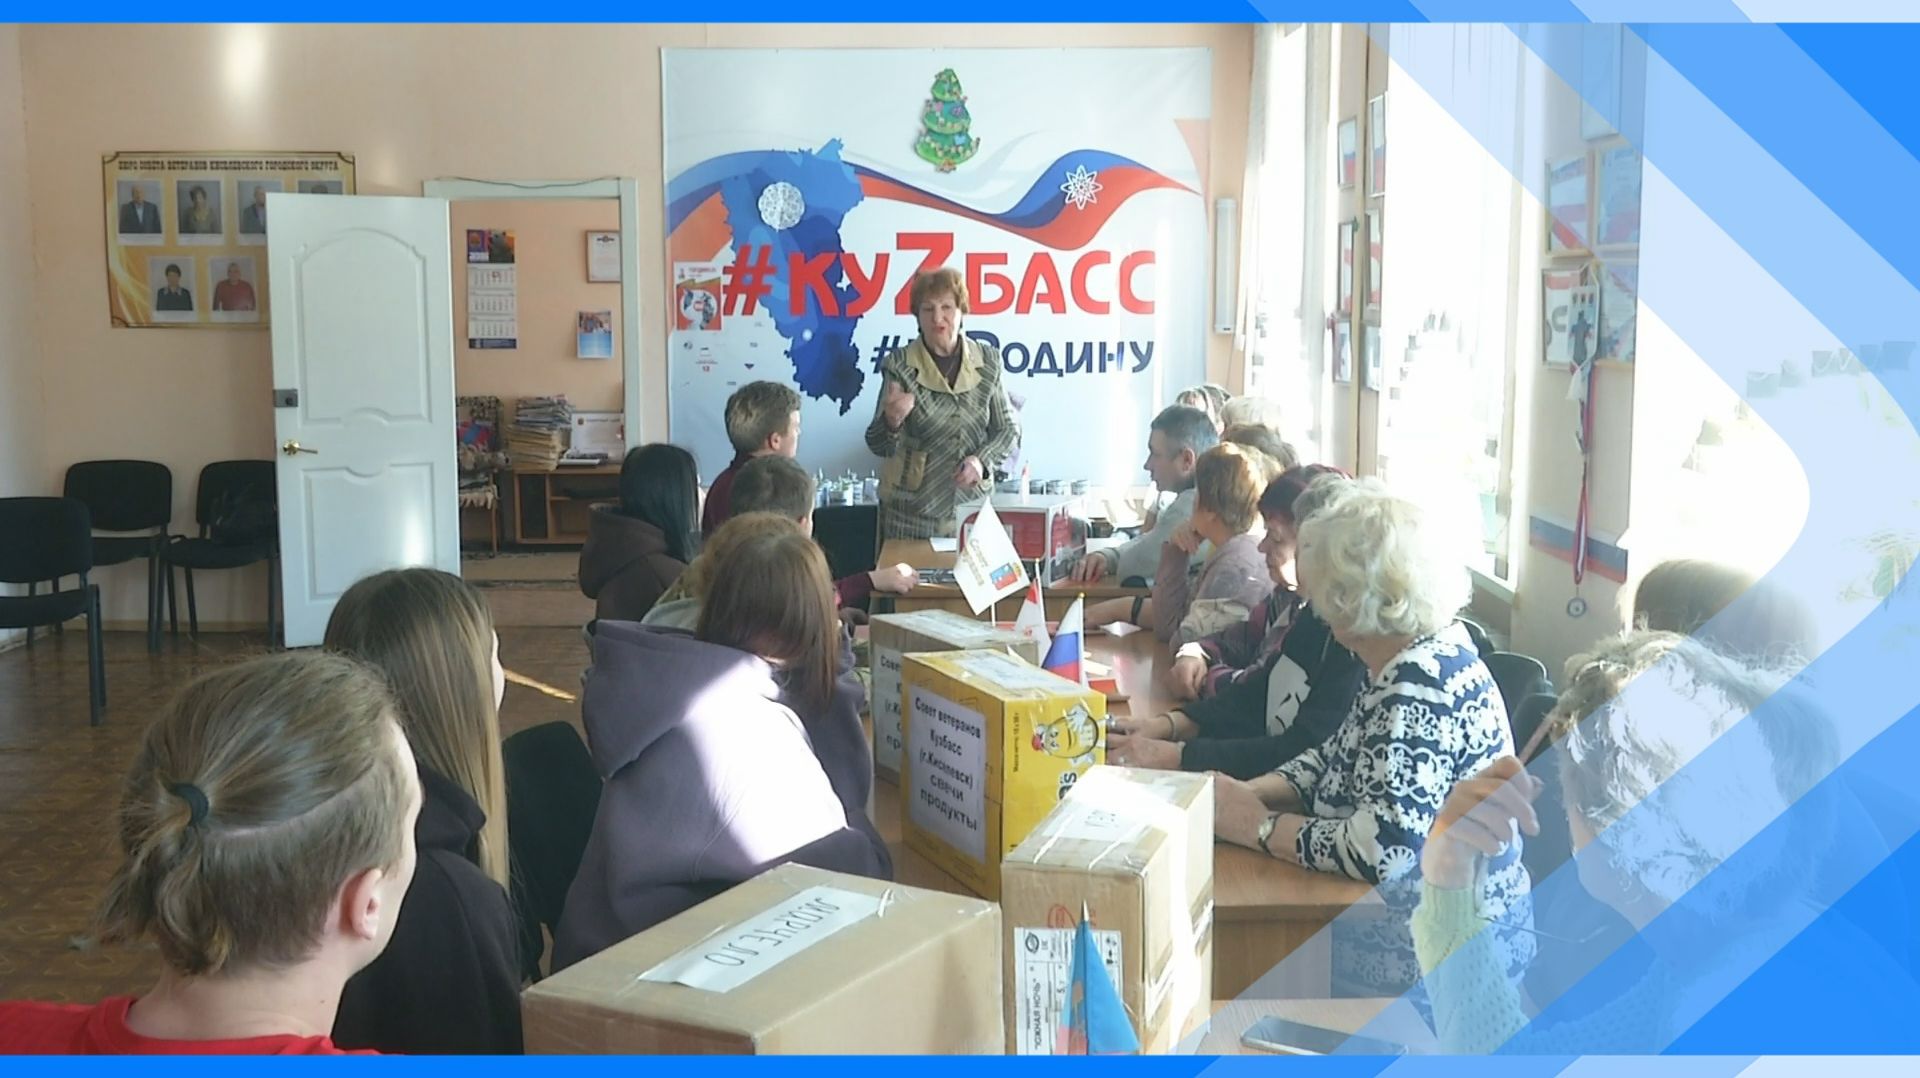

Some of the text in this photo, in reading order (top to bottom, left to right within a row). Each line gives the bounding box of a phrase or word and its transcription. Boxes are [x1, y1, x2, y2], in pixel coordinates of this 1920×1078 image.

[914, 696, 937, 718] Совет
[938, 710, 981, 739] ветеранов
[929, 728, 963, 756] Кузбасс
[930, 773, 964, 803] свечи
[919, 788, 978, 832] продукты
